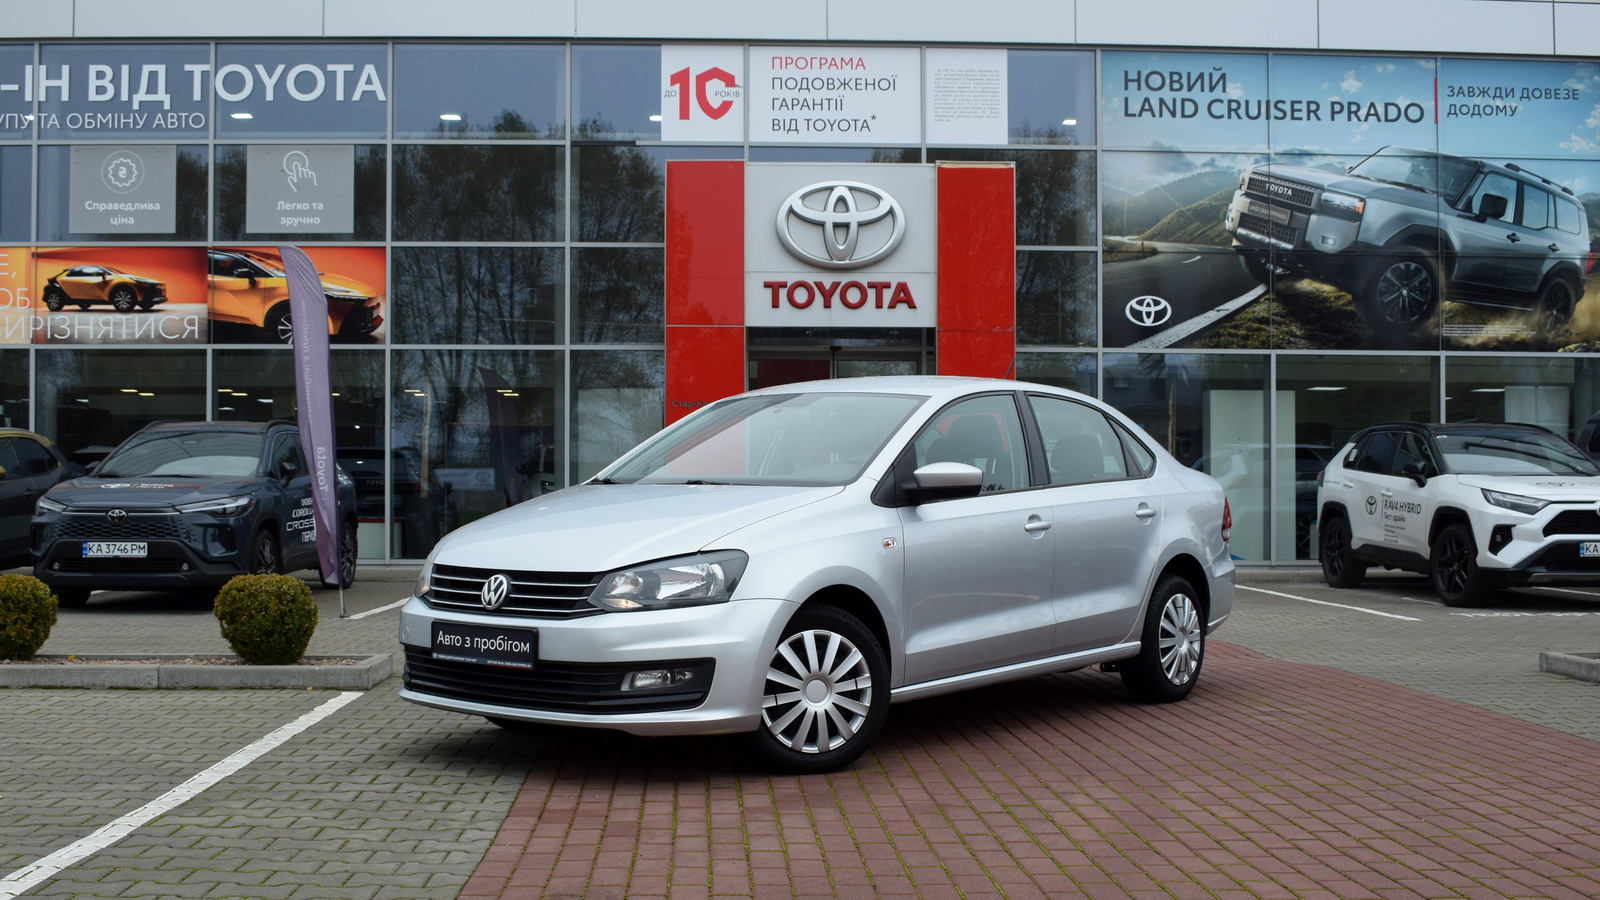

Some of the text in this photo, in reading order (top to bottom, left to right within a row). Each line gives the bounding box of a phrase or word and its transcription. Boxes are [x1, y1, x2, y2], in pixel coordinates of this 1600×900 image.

[772, 56, 866, 70] ПРОГРАМА
[88, 65, 171, 110] ВІД
[184, 64, 387, 102] TOYOTA
[772, 75, 898, 93] ПОДОВЖЕНОЇ
[1123, 68, 1228, 93] НОВИЙ
[664, 90, 677, 98] ДО
[1446, 86, 1579, 102] ЗАВЖДИ ДОВЕЗЕ
[772, 96, 844, 111] ГАРАНТІЇ
[1124, 97, 1425, 124] LAND CRUISER PRADO
[1446, 103, 1519, 118] ДОДОМУ
[38, 114, 60, 129] ТА
[66, 113, 148, 129] ОБМІНУ
[153, 113, 206, 129] АВТО
[772, 118, 800, 134] ВІД
[1266, 183, 1292, 195] TOYOTA
[84, 200, 161, 212] Справедлива
[276, 200, 324, 212] Легко та
[110, 215, 135, 226] ціна
[280, 216, 321, 227] зручно
[763, 280, 918, 310] TOYOTA
[0, 315, 200, 340] ИРІЗНЯТИСЯ
[1384, 500, 1421, 514] RAV4 HYBRID
[286, 519, 314, 531] CROSS
[88, 544, 146, 554] KA 3746 PM
[437, 631, 529, 652] Авто з пробігом
